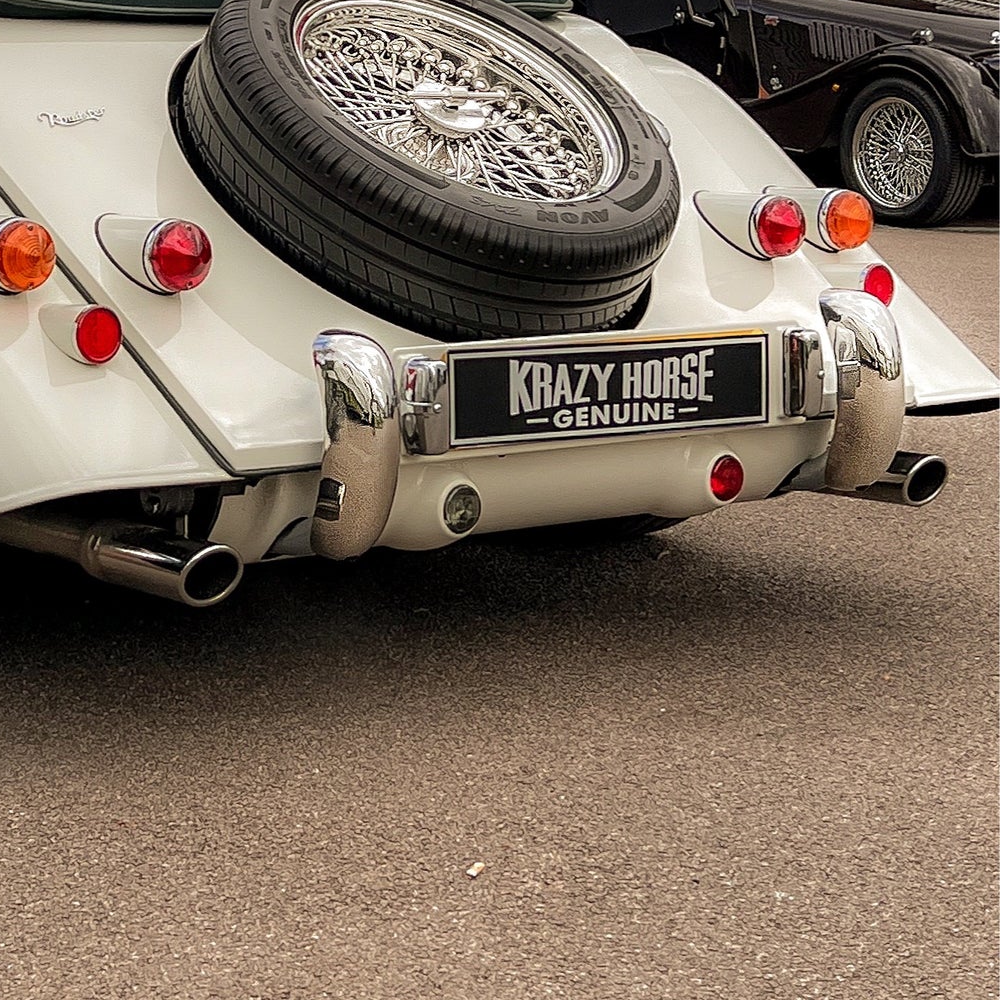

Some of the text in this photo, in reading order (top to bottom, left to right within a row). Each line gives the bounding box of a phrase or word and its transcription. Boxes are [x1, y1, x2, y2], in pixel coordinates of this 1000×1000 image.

[537, 208, 609, 225] AVON
[509, 349, 715, 416] KRAZY HORSE
[553, 402, 676, 429] GENUINE
